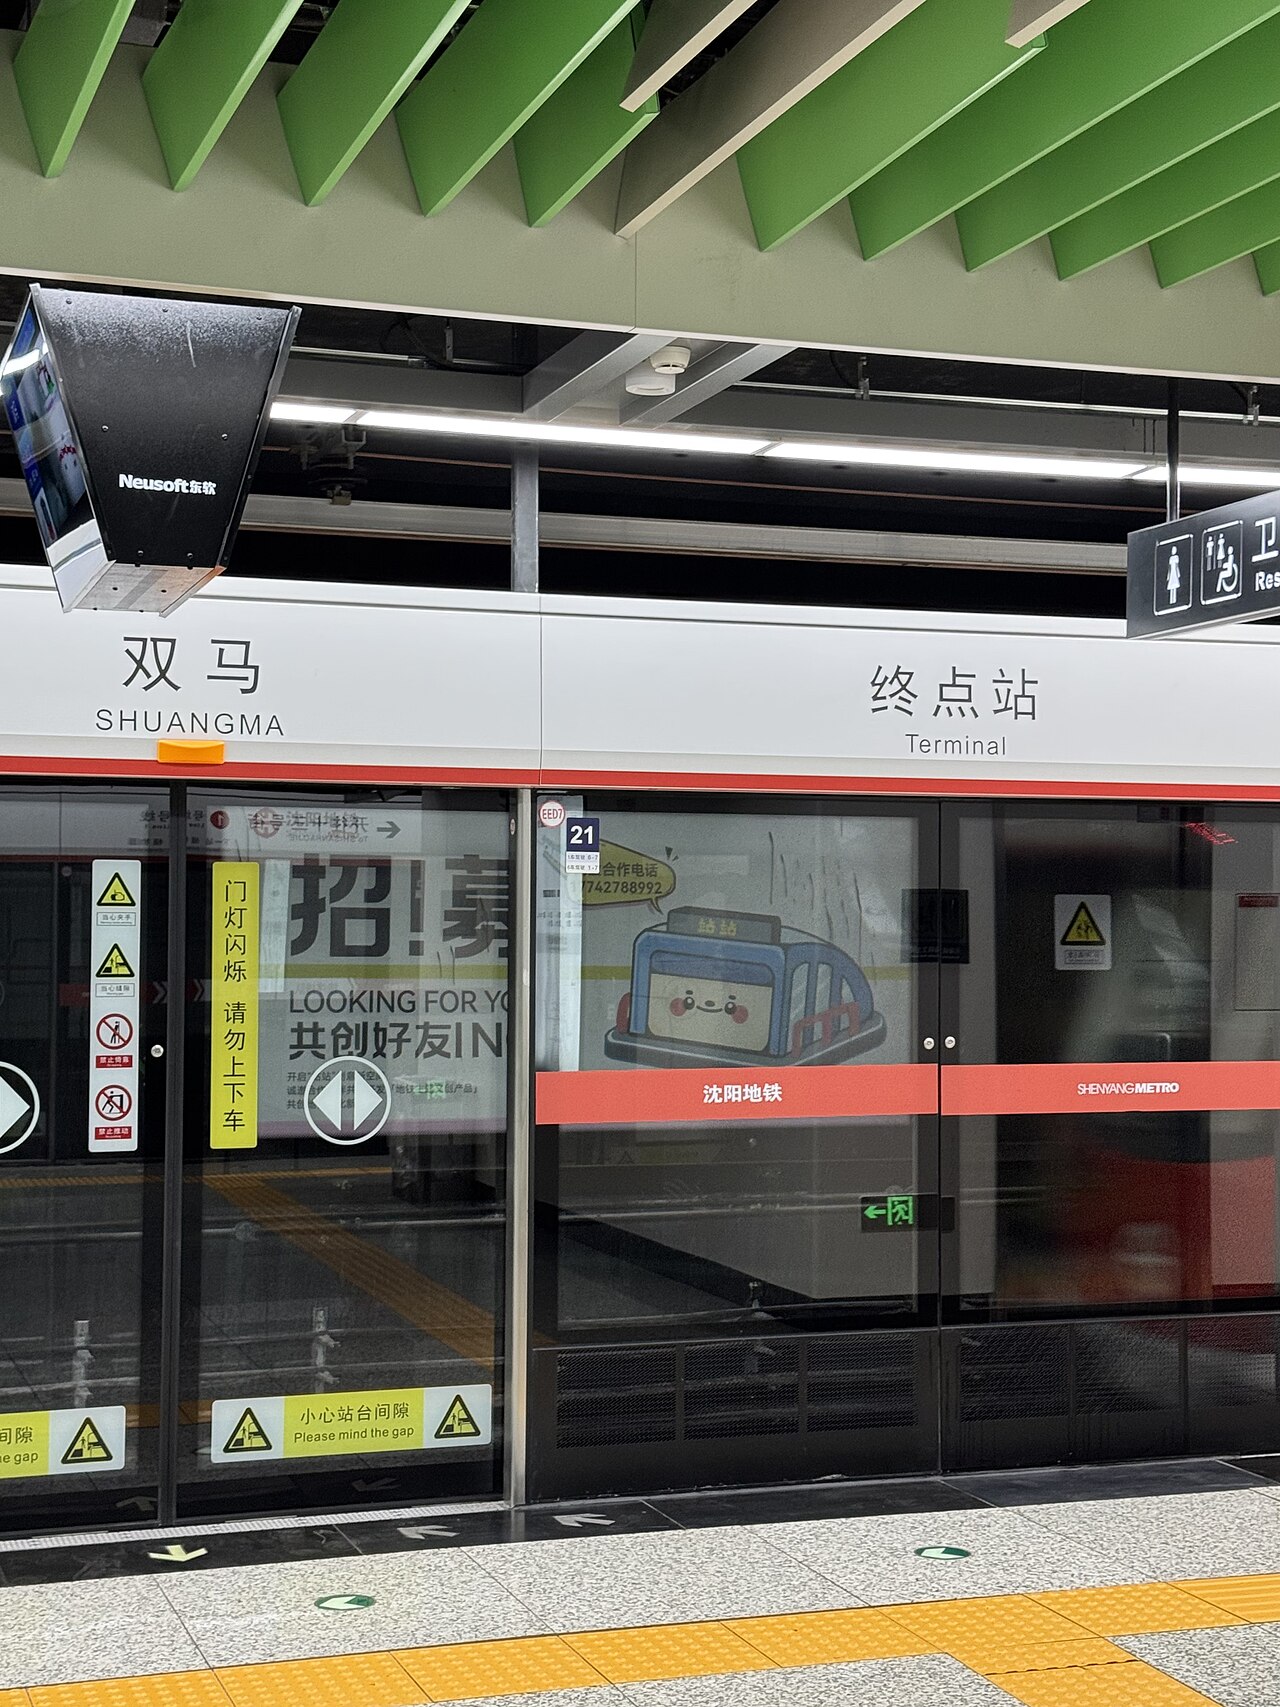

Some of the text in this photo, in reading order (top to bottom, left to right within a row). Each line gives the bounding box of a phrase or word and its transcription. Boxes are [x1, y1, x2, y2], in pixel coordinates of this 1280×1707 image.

[122, 636, 261, 695] 双马
[870, 664, 1039, 720] 终点站
[96, 708, 284, 736] SHUANGMA
[905, 734, 1006, 756] Terminal
[542, 809, 562, 819] EED7
[570, 825, 593, 844] 21
[600, 862, 658, 877] 合作电话
[223, 880, 247, 1132] 门灯闪烁 请勿上下车
[290, 989, 416, 1014] LOOKING
[425, 990, 478, 1013] FOR
[290, 1021, 508, 1060] 共创好友IN
[703, 1083, 782, 1104] 沈阳地铁
[300, 1402, 409, 1425] 小心站台间隙
[294, 1427, 414, 1443] Please mind the gap
[14, 1452, 39, 1465] gap
